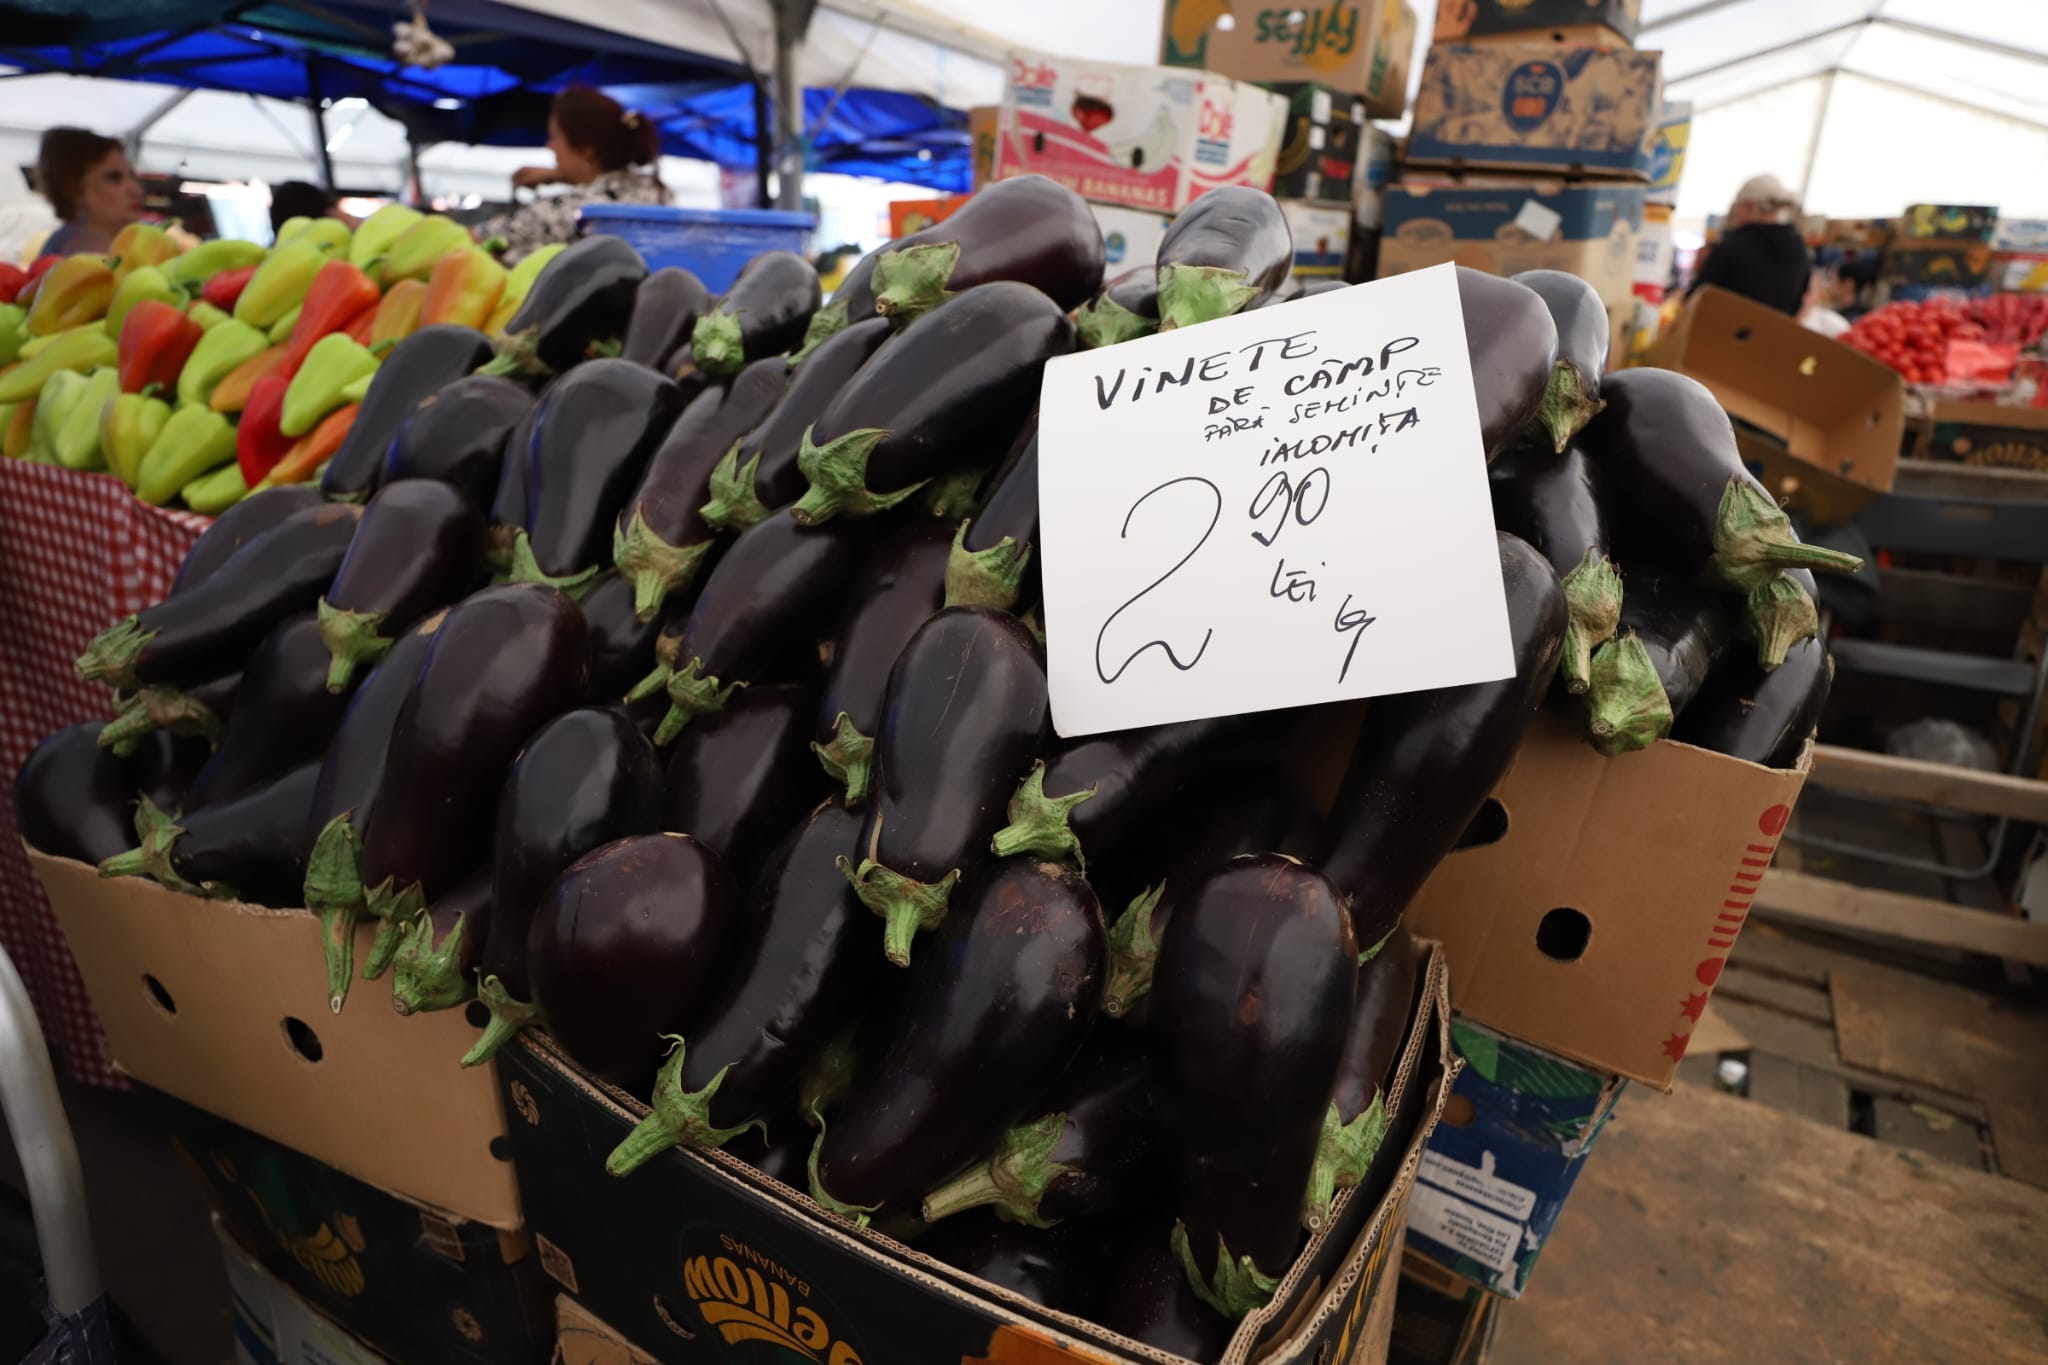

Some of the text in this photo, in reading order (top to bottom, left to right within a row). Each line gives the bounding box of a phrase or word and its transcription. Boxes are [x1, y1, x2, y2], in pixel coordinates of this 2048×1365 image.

[1207, 385, 1255, 415] DE
[1096, 467, 1331, 684] 2 90
[719, 1233, 810, 1297] BANANAS
